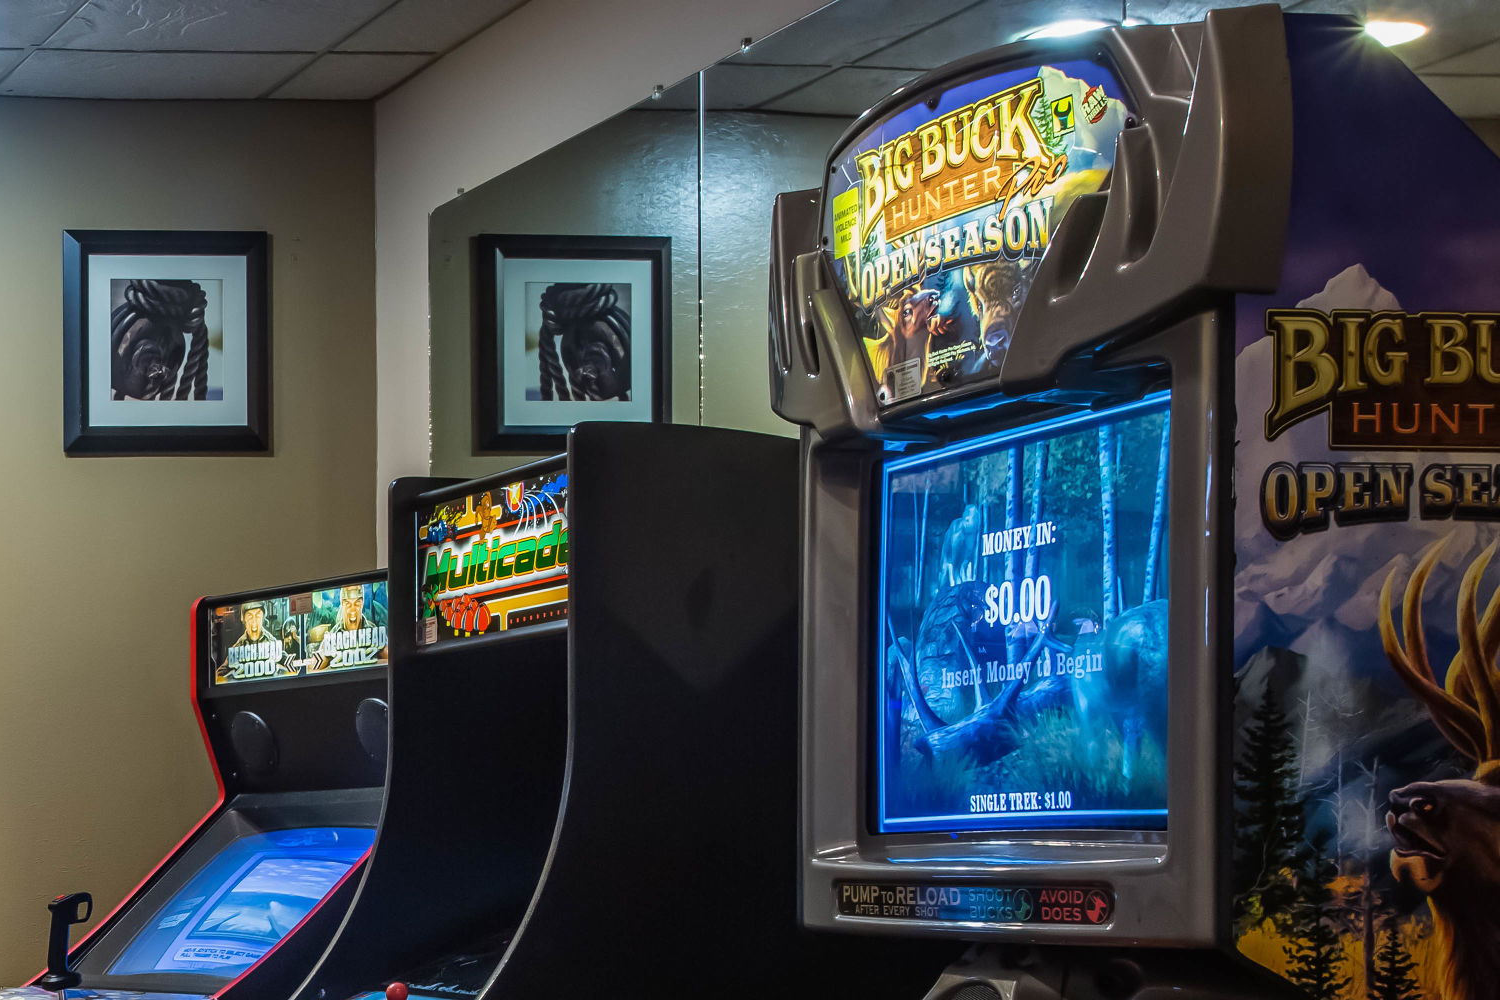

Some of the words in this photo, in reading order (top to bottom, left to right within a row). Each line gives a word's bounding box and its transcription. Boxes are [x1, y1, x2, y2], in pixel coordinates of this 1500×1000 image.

[857, 136, 913, 243] BIG
[920, 83, 1052, 181] BUCK
[891, 166, 1001, 231] HUNTER
[995, 155, 1068, 221] Pro
[862, 244, 919, 306] OPEN
[925, 200, 1052, 268] SEASON
[1270, 316, 1409, 426] BIG
[1263, 464, 1409, 521] OPEN
[1423, 464, 1500, 507] SE
[981, 526, 1032, 557] MONEY
[1034, 521, 1056, 547] IN:
[984, 574, 1051, 627] $0.00
[324, 628, 356, 653] BEACH
[356, 624, 387, 650] HEAD
[228, 643, 258, 667] BEACH
[258, 640, 283, 662] HEAD
[330, 646, 379, 668] 2002
[234, 659, 276, 679] 2000
[941, 666, 981, 689] Insert
[986, 659, 1032, 687] Money
[1056, 651, 1103, 681] Begin
[970, 793, 1007, 812] SINGLE
[1008, 792, 1042, 811] TREK:
[1044, 790, 1072, 810] $1.00
[843, 886, 879, 903] PUMP
[881, 891, 894, 904] TO
[896, 887, 961, 906] RELOAD
[968, 889, 1012, 902] SHOOT
[1039, 890, 1084, 904] AVOID
[855, 905, 879, 915] AFTER
[883, 905, 910, 916] EVERY
[915, 906, 939, 917] SHOT
[969, 906, 1013, 919] BUCKS
[1041, 906, 1082, 921] DOES
